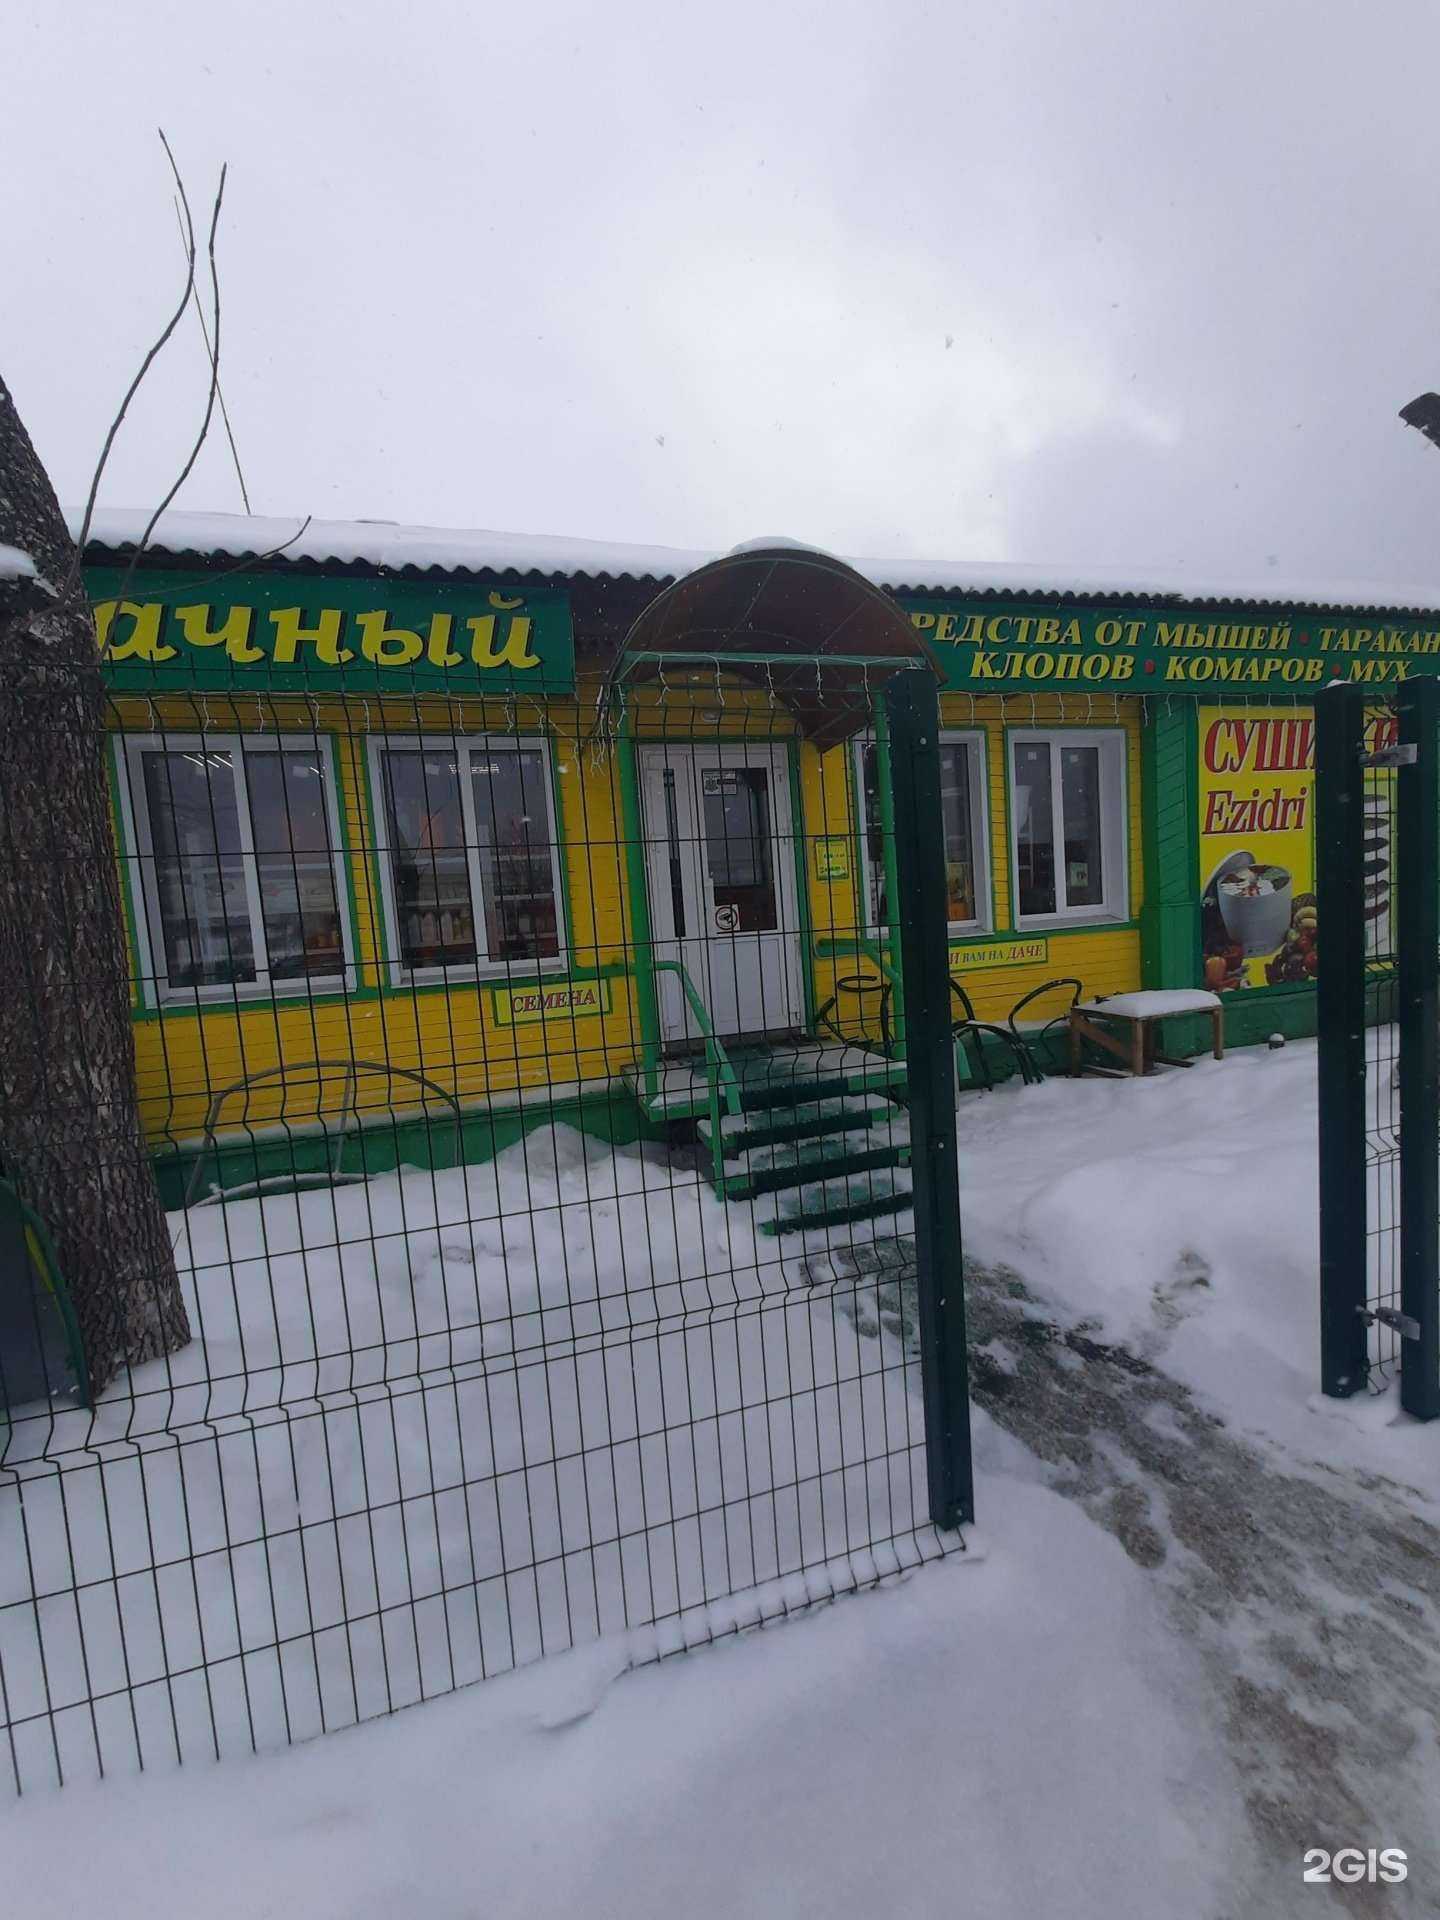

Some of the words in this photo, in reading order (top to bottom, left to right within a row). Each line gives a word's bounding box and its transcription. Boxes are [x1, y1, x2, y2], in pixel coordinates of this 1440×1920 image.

[1094, 620, 1147, 647] ОТ
[1152, 621, 1292, 650] МЫШЕЙ
[969, 651, 1136, 681] КЛОПОВ
[1164, 655, 1326, 682] КОМАРОВ
[1350, 659, 1413, 682] МУХ
[1202, 786, 1308, 835] Ezidri
[1006, 944, 1043, 960] ДАЧЕ
[512, 988, 596, 1014] СЕМЕНА
